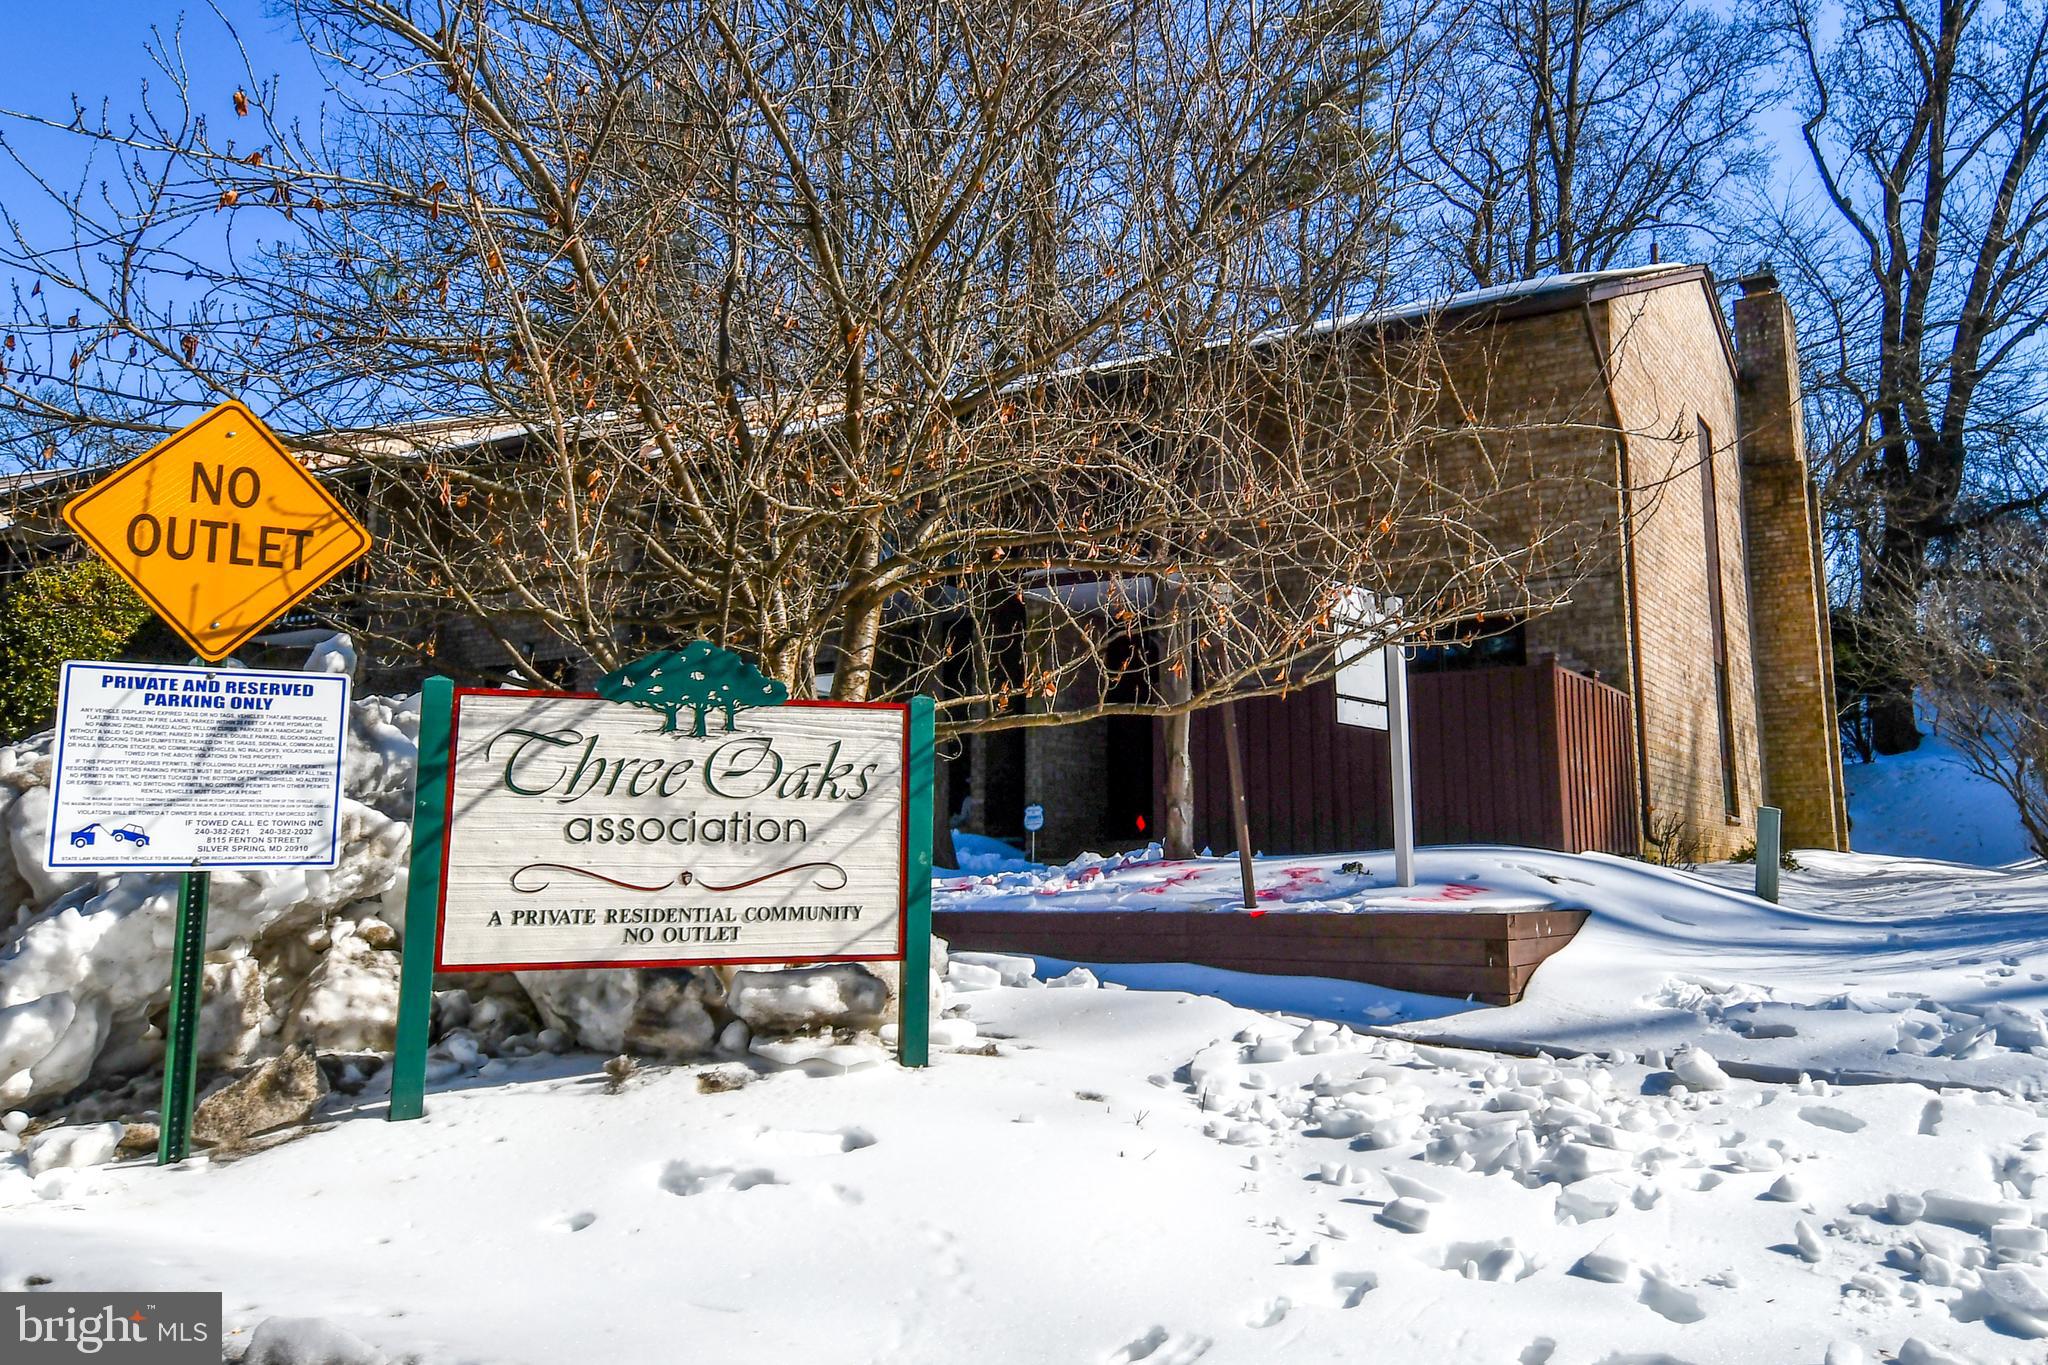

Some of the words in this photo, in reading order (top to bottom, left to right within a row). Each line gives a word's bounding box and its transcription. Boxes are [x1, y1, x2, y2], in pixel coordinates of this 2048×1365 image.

[190, 462, 260, 508] NO
[126, 514, 314, 570] OUTLET
[101, 674, 179, 690] PRIVATE
[181, 678, 220, 692] AND
[222, 679, 313, 696] RESERVED
[143, 692, 225, 708] PARKING
[227, 695, 274, 710] ONLY
[485, 728, 693, 805] Three
[704, 737, 879, 800] Oaks
[564, 811, 807, 843] association
[488, 911, 502, 927] A
[512, 908, 596, 926] PRIVATE
[606, 907, 736, 924] RESIDENTIAL
[744, 905, 863, 921] COMMUNITY
[623, 928, 655, 944] NO
[664, 926, 741, 942] OUTLET
